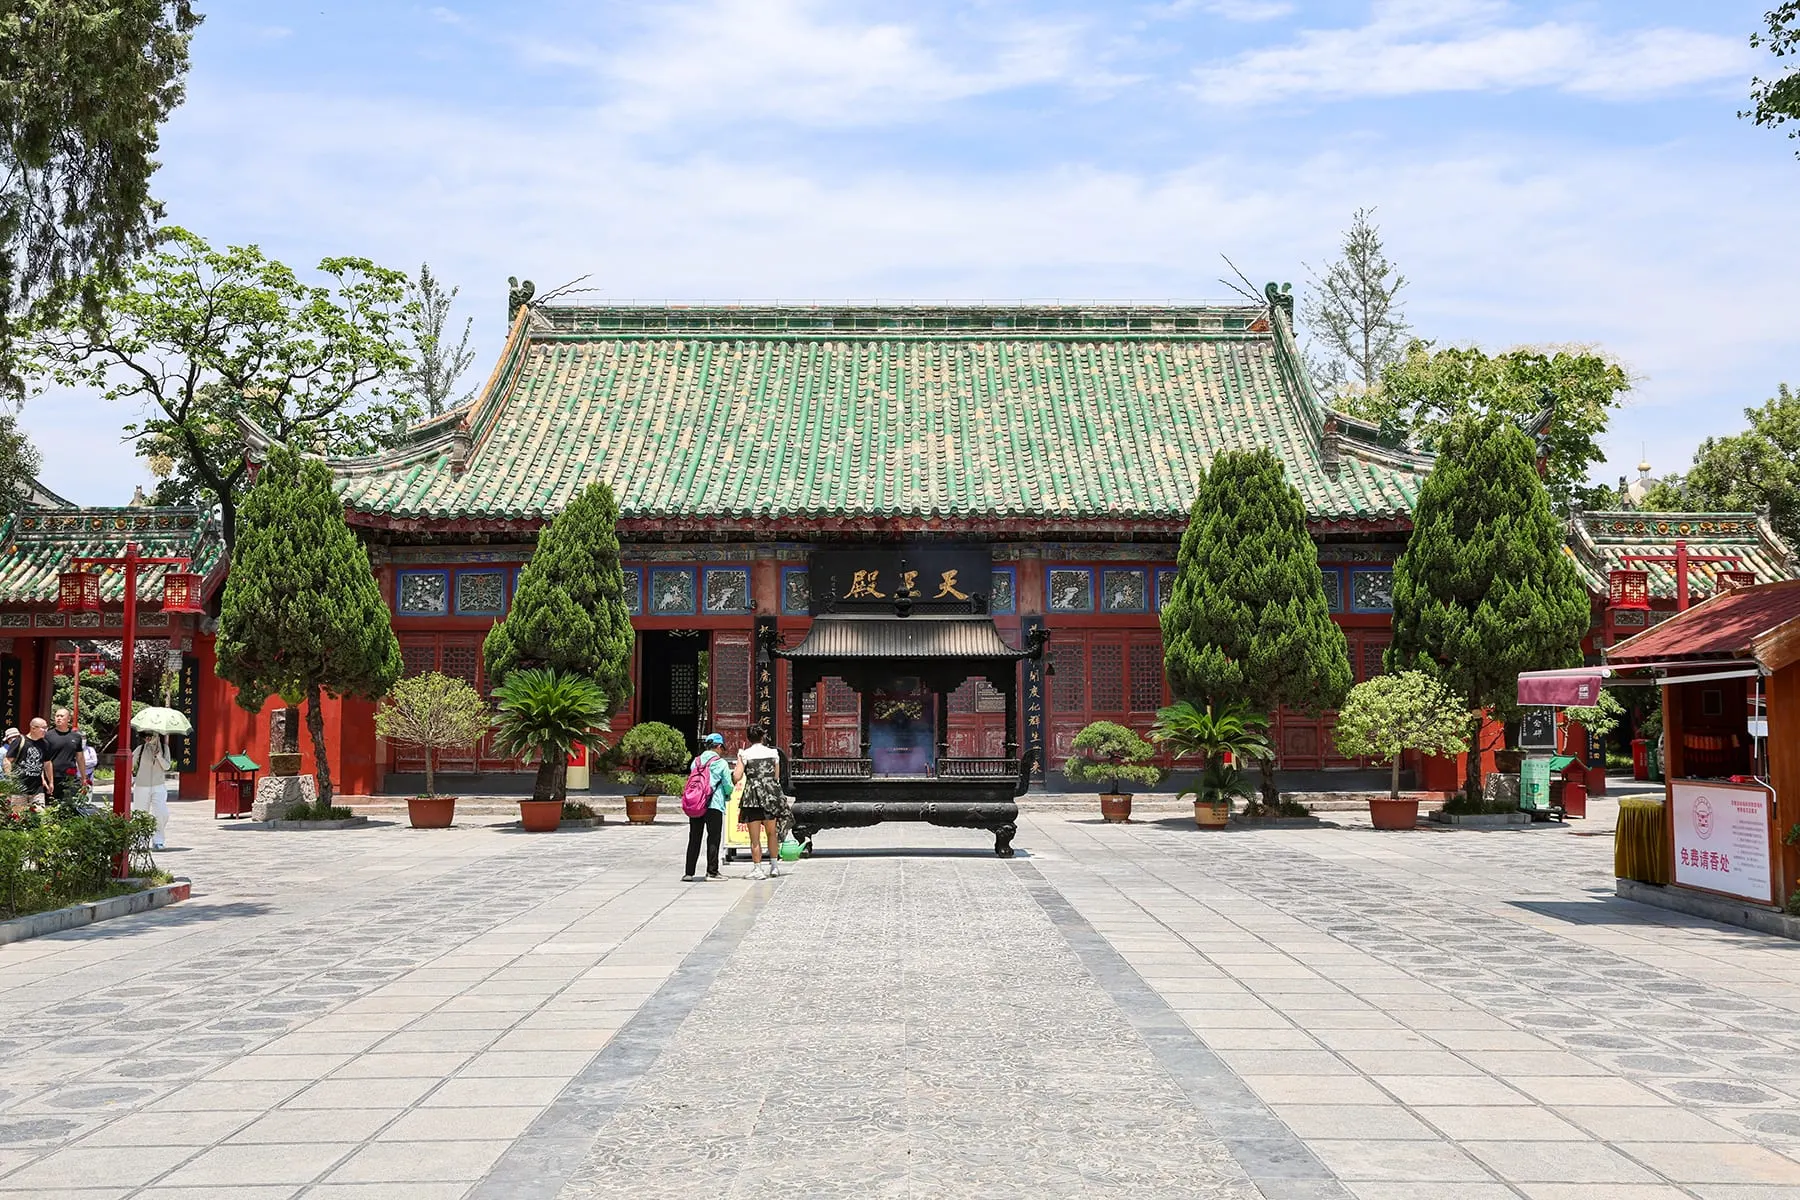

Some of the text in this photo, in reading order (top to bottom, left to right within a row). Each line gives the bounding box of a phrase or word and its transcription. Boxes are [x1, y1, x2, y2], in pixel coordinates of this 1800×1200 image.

[1681, 847, 1730, 872] 免费请香处
